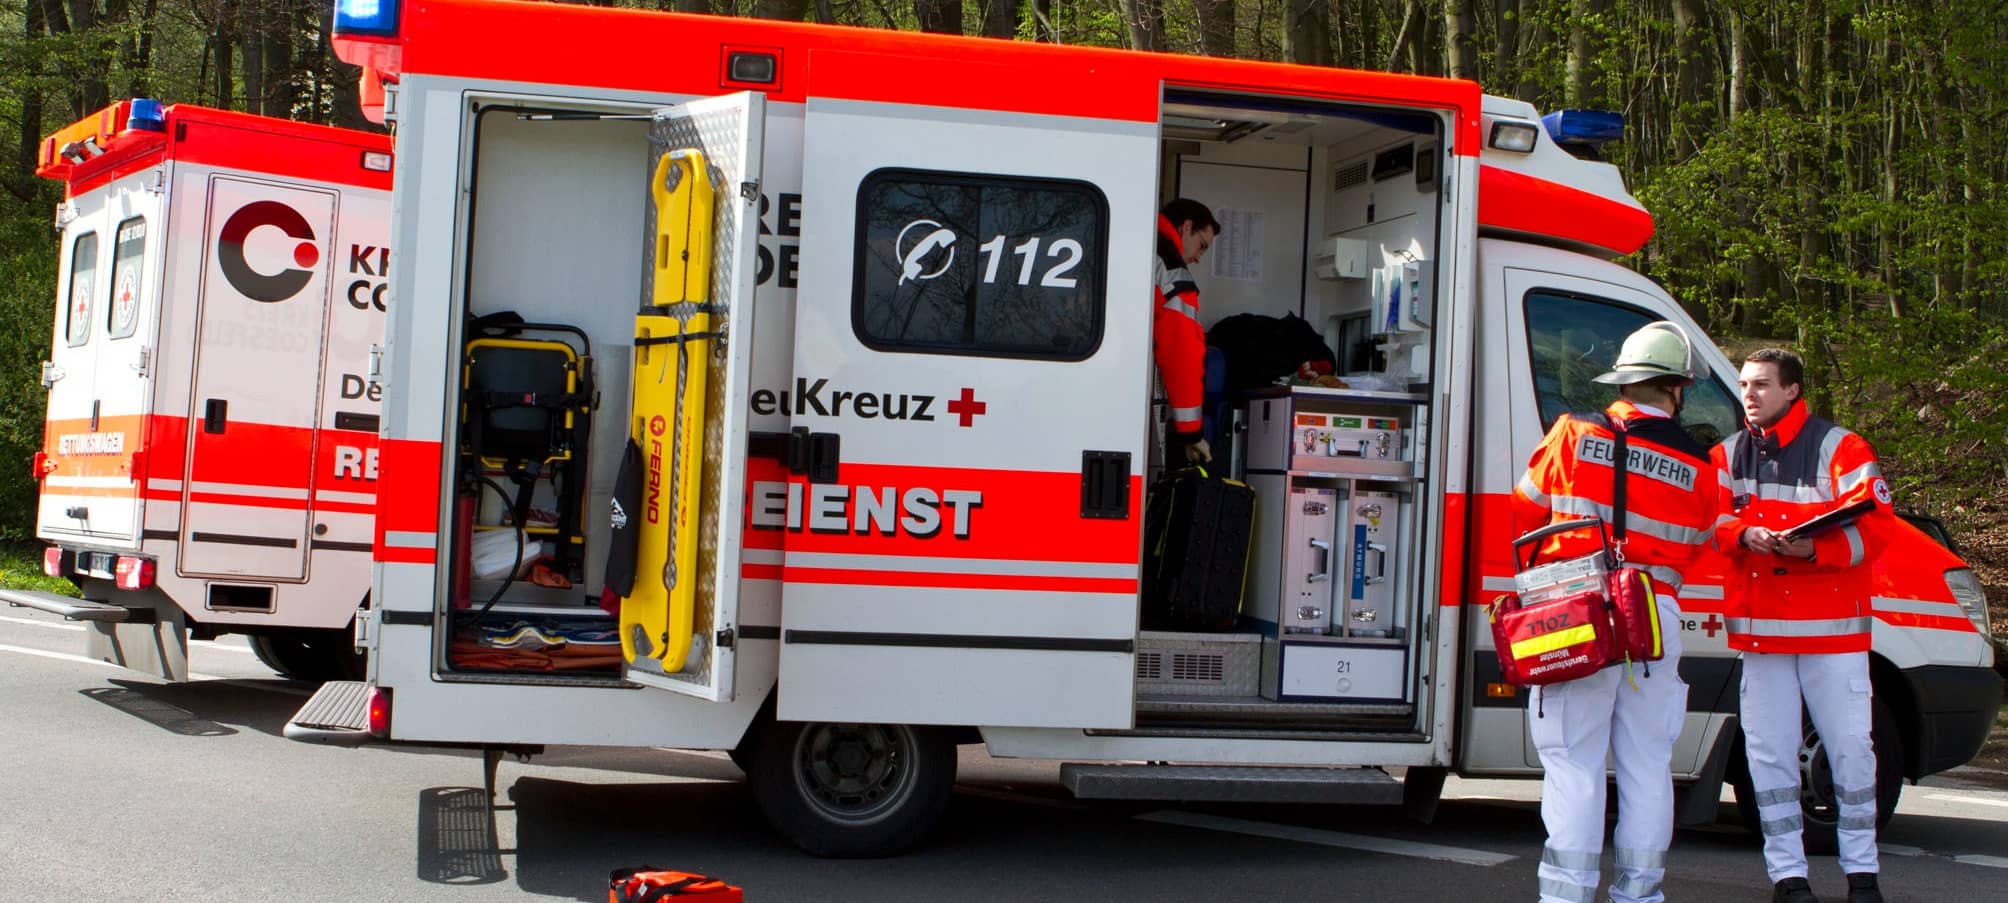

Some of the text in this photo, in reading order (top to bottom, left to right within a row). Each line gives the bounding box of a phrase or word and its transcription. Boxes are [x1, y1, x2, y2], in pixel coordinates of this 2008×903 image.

[980, 235, 1083, 289] 112
[647, 438, 662, 526] FERNO
[1582, 439, 1692, 486] FEURWEHR
[1526, 613, 1570, 635] ZOLL
[1337, 660, 1351, 673] 21
